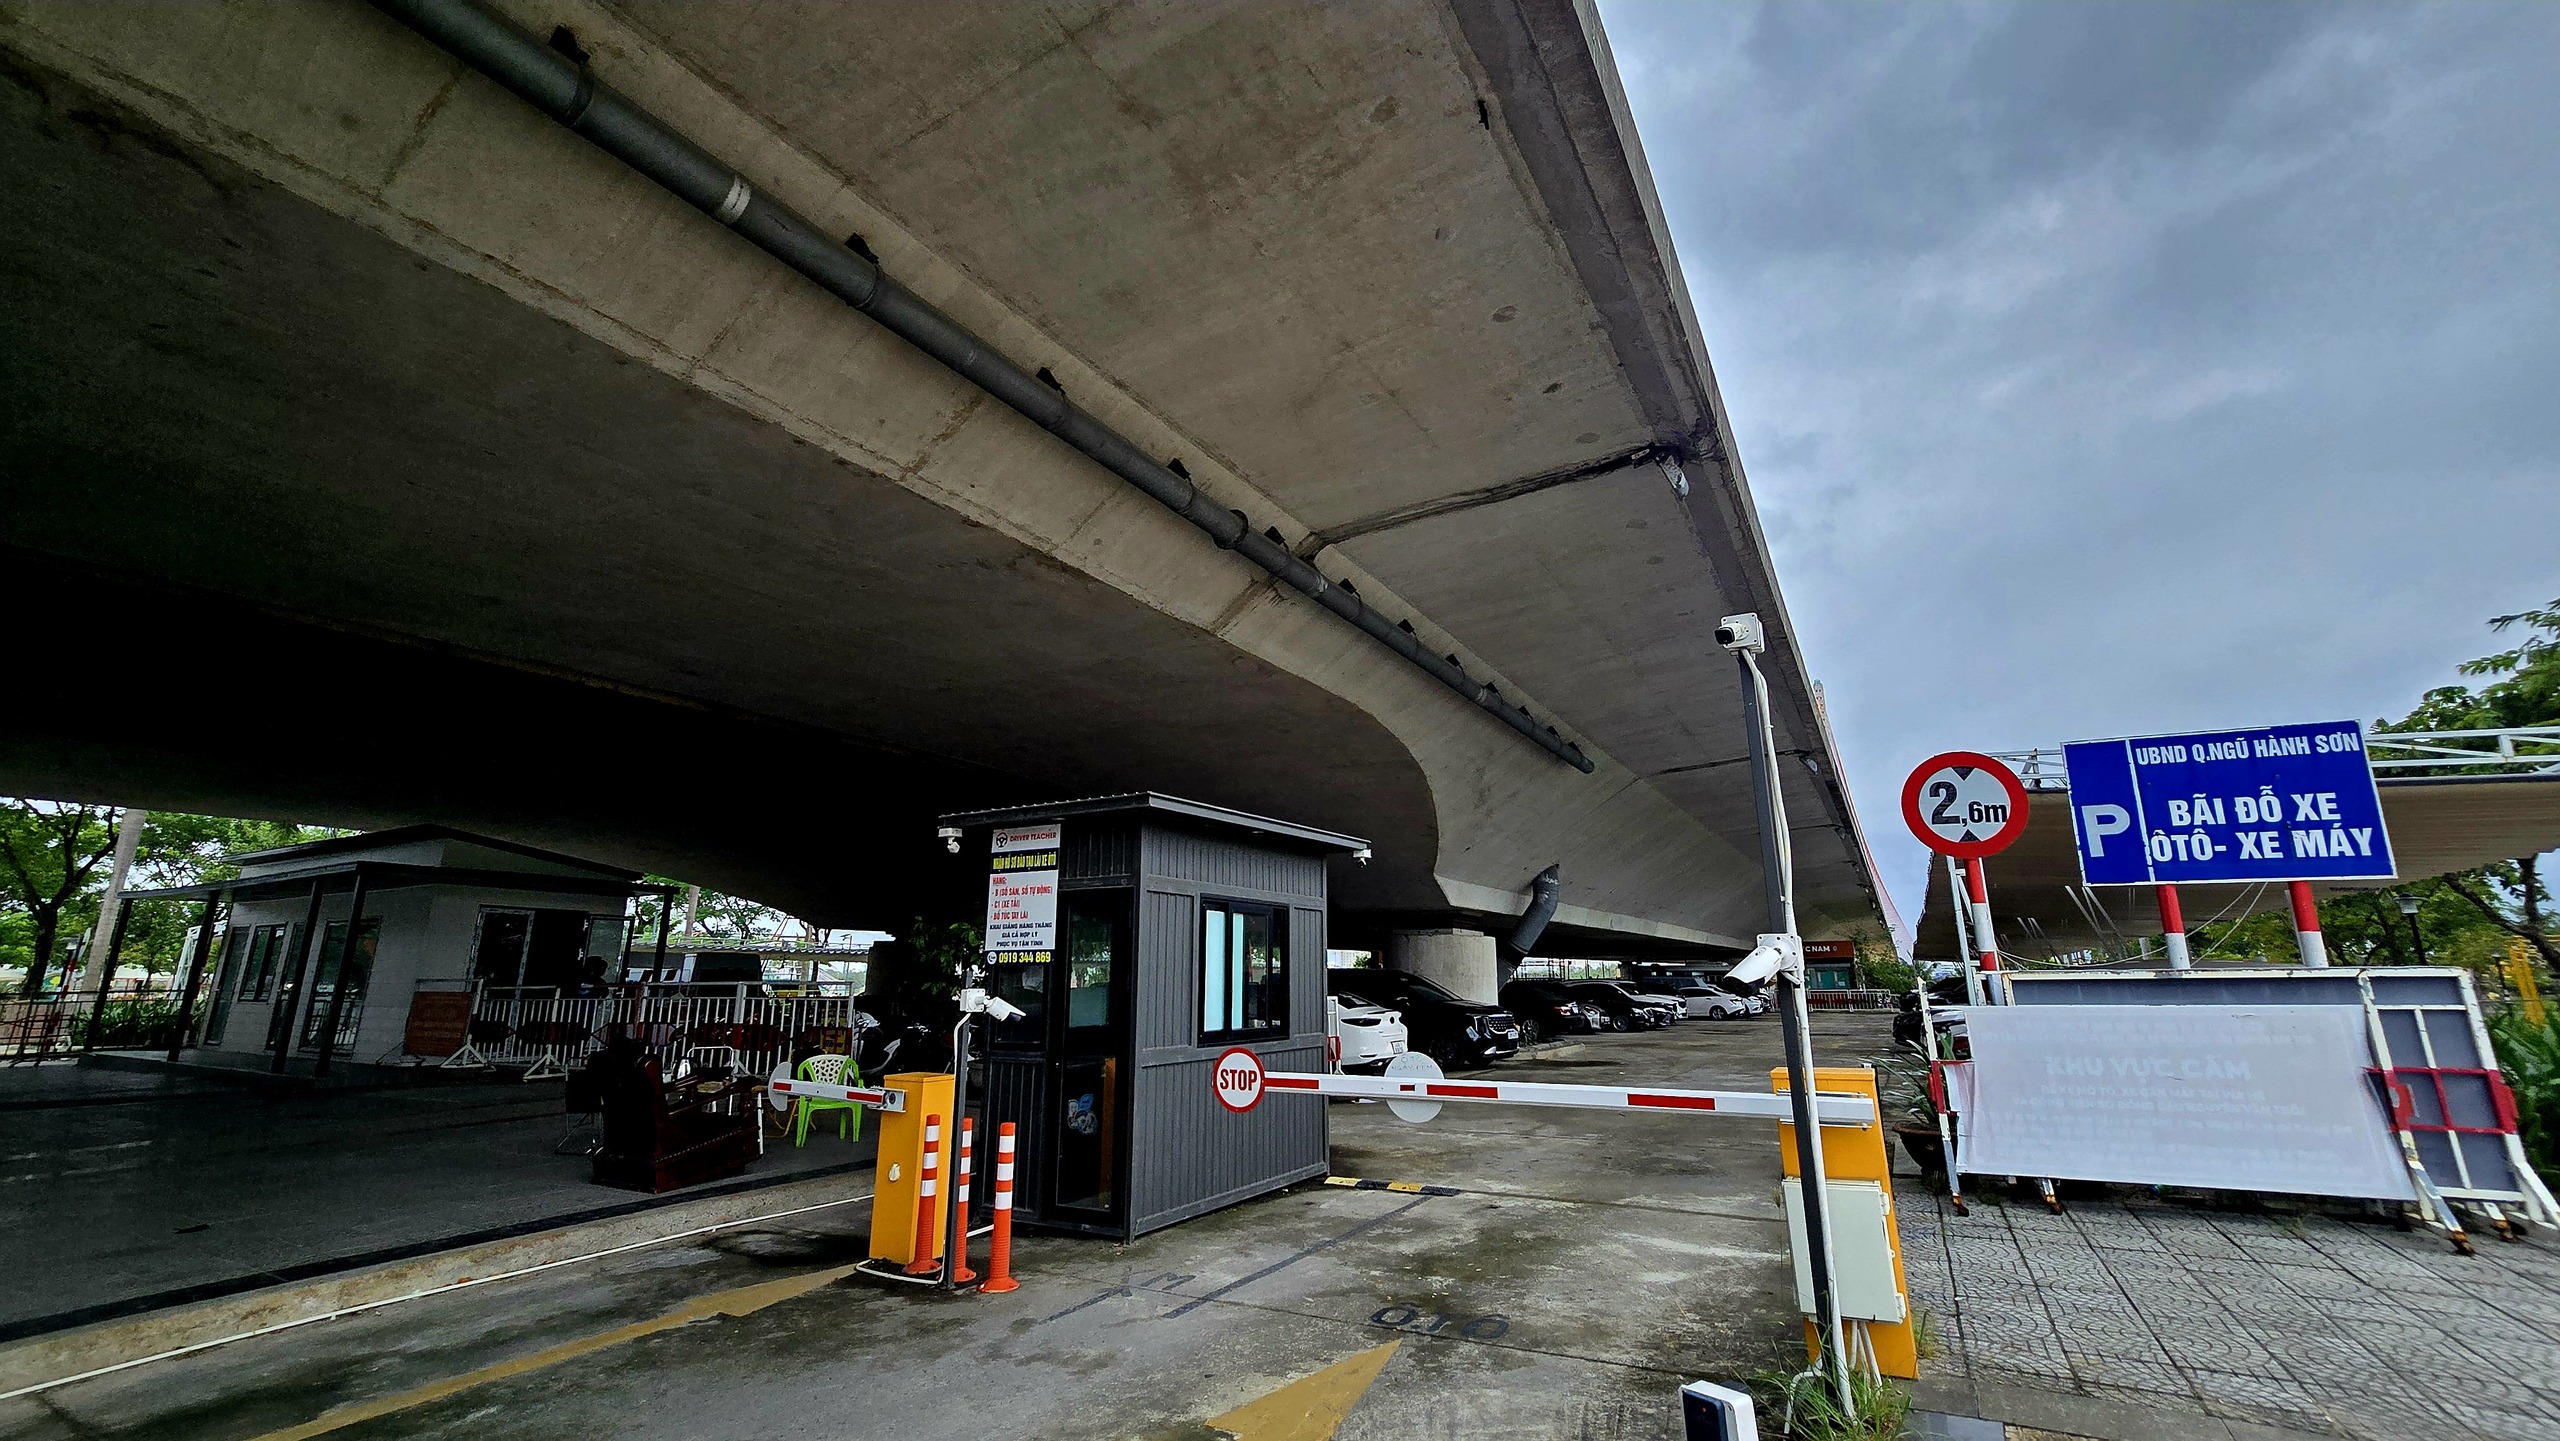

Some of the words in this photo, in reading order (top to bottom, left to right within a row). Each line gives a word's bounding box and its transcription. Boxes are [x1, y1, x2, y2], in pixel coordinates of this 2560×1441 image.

[2135, 745, 2187, 765] UBND
[2193, 738, 2249, 763] Q.NGŨ
[2256, 735, 2310, 757] HÀNH
[2315, 732, 2360, 754] SƠN
[1929, 781, 2008, 827] 2,6m
[2167, 793, 2226, 827] BÃI
[2234, 785, 2283, 824] ĐỖ
[2290, 792, 2341, 822] XE
[1031, 832, 1056, 840] TEACHER
[2081, 803, 2131, 858] P
[2235, 831, 2284, 860] XE
[2292, 823, 2373, 858] MÁY
[999, 952, 1017, 963] 0919
[1019, 952, 1033, 963] 344
[1035, 951, 1051, 962] 869
[1220, 1069, 1257, 1091] STOP
[2045, 1056, 2104, 1076] KHU
[2109, 1057, 2174, 1084] VỰC
